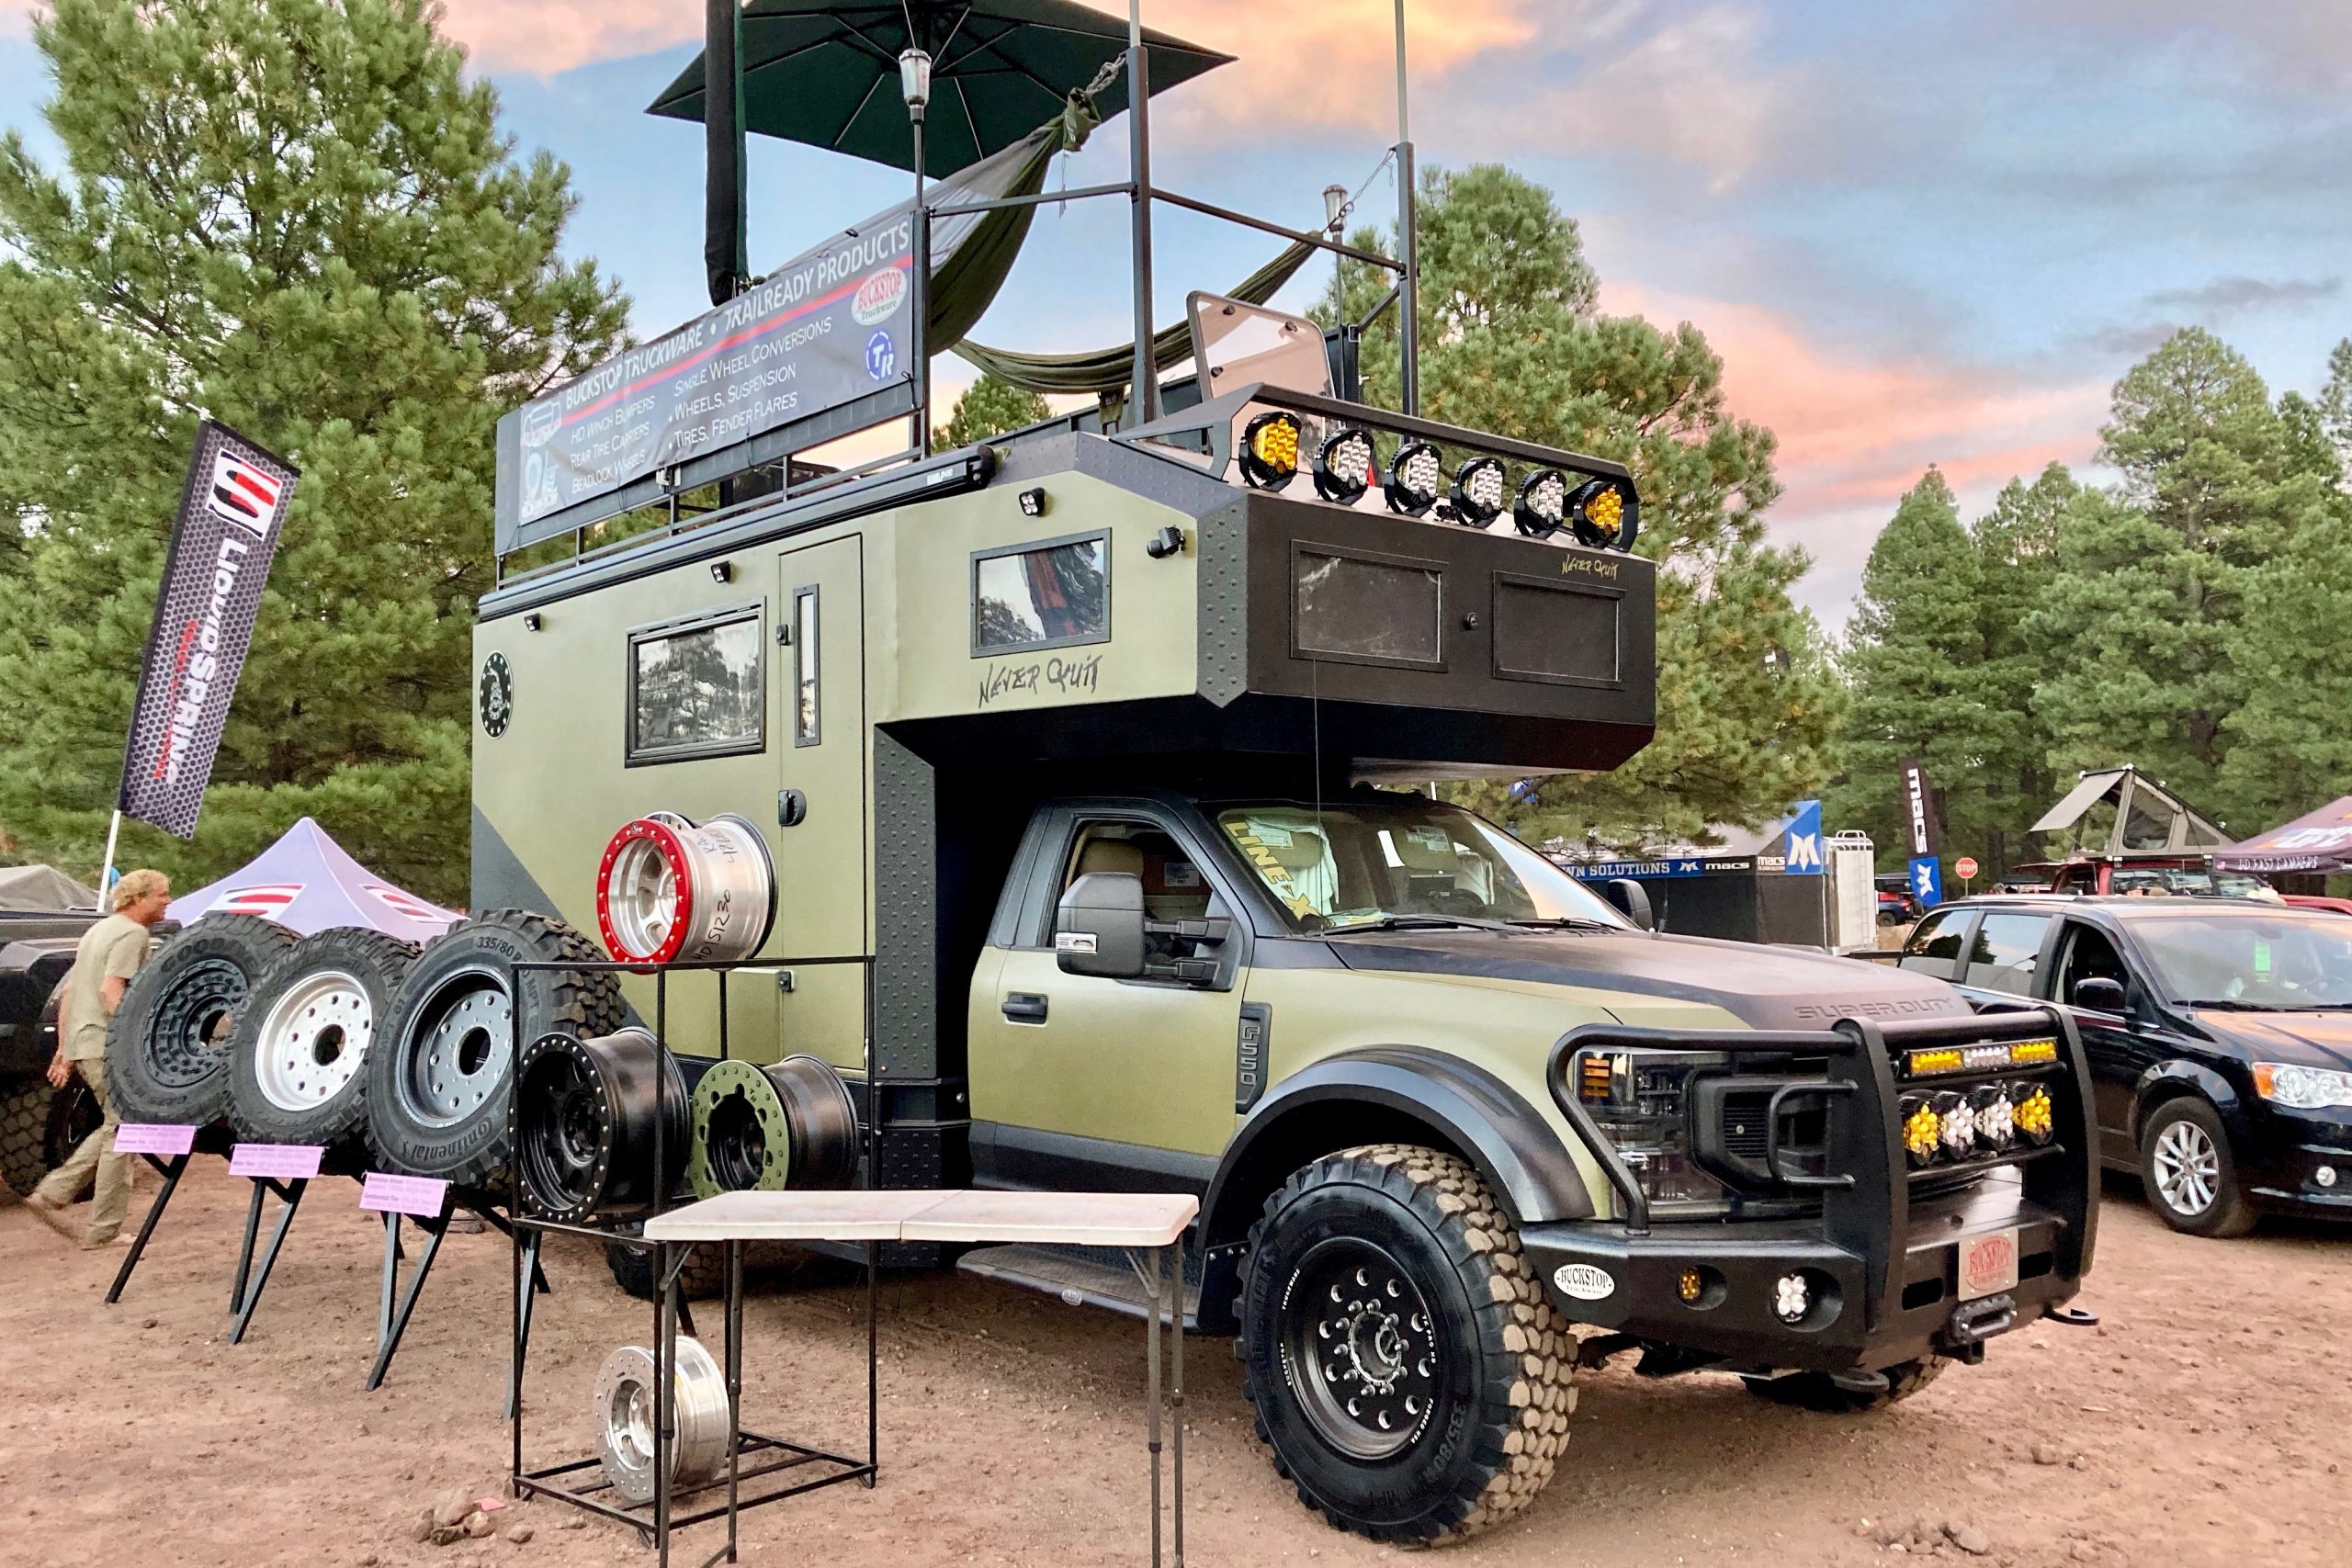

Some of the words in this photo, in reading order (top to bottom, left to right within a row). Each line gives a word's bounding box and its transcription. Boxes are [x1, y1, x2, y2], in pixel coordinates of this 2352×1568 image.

[858, 271, 902, 310] BUCKSTOP
[566, 363, 623, 411] BUCKSTOP
[625, 323, 704, 380] TRUCKWARE
[724, 266, 814, 332] TRAILREADY
[817, 220, 910, 288] PRODUCTS
[861, 299, 898, 321] Truckware
[709, 354, 752, 381] WHEEL
[752, 316, 832, 364] CONVERSIONS
[674, 392, 725, 422] WHEELS,
[728, 363, 797, 403] SUSPENSION
[571, 426, 585, 446] HD
[587, 414, 614, 439] WINCH
[615, 395, 655, 425] BUMPERS
[674, 426, 709, 449] TIRES,
[712, 408, 753, 437] FENDER
[754, 391, 798, 424] FLARES
[571, 450, 591, 469] REAR
[593, 441, 611, 459] TIRE
[611, 421, 650, 452] CARRIERS
[571, 466, 613, 495] BEADLOCK
[1562, 553, 1592, 576] NEVER
[978, 662, 1041, 709] NEVER
[1907, 768, 1928, 853] macs
[1589, 862, 1670, 876] SOLUTIONS
[1705, 862, 1750, 870] macs
[1758, 856, 1786, 866] macs
[1958, 863, 1976, 873] STOP
[2252, 858, 2274, 871] FAST
[2276, 855, 2320, 870] CAMPERS
[476, 935, 515, 957] 335/80
[1793, 1002, 1898, 1019] SUPER
[1896, 998, 1954, 1013] DUTY
[1561, 1268, 1609, 1288] BUCKSTOP
